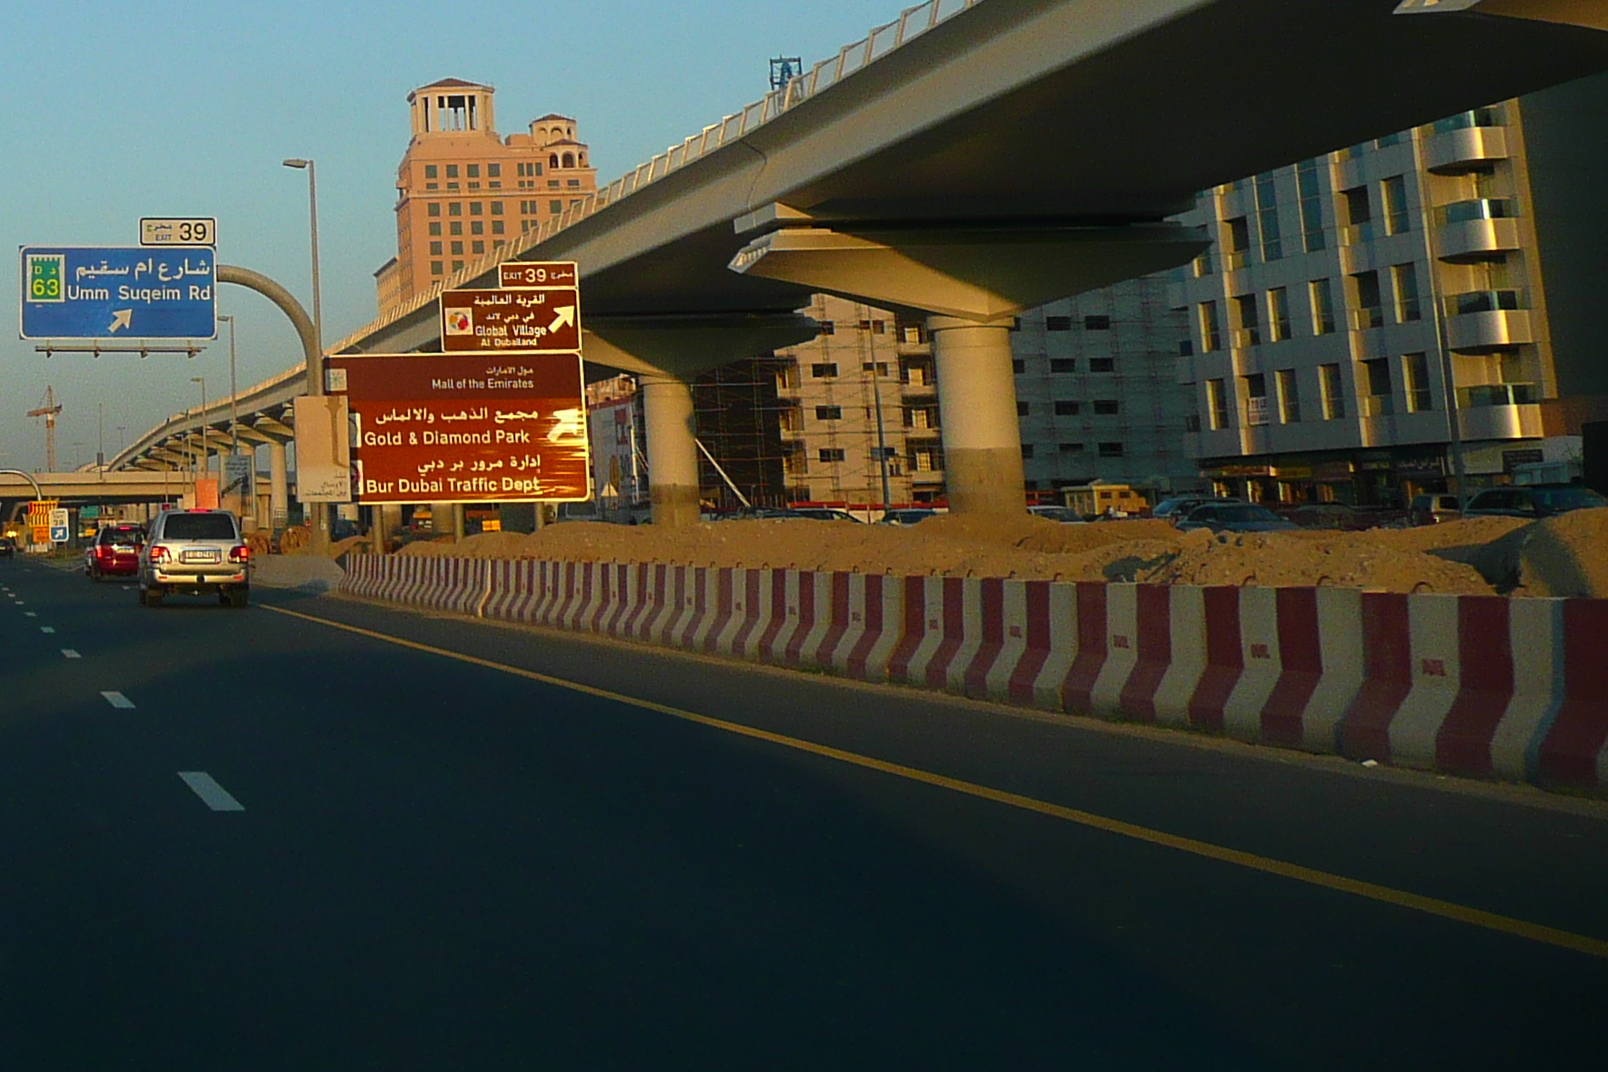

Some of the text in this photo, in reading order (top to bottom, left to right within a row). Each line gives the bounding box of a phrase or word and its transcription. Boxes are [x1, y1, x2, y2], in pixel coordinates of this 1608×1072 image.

[179, 222, 207, 241] 39
[34, 266, 42, 274] D
[76, 258, 210, 281] شارع ام سقيم
[503, 268, 546, 283] EXIT 39
[32, 279, 59, 296] 63
[67, 285, 211, 304] Umm Suqeim Rd
[474, 294, 545, 308] القرية العالمية
[475, 325, 547, 338] Global Village
[494, 338, 537, 346] Dubailand
[432, 378, 534, 389] Mall of the Emirates
[440, 407, 489, 421] الذهب
[494, 410, 539, 424] مجمع
[364, 429, 530, 446] Gold & Diamond Park
[417, 459, 444, 476] دبي
[449, 459, 464, 473] بر
[470, 459, 503, 473] مرور
[366, 476, 541, 494] Bur Dubai Traffic Dept
